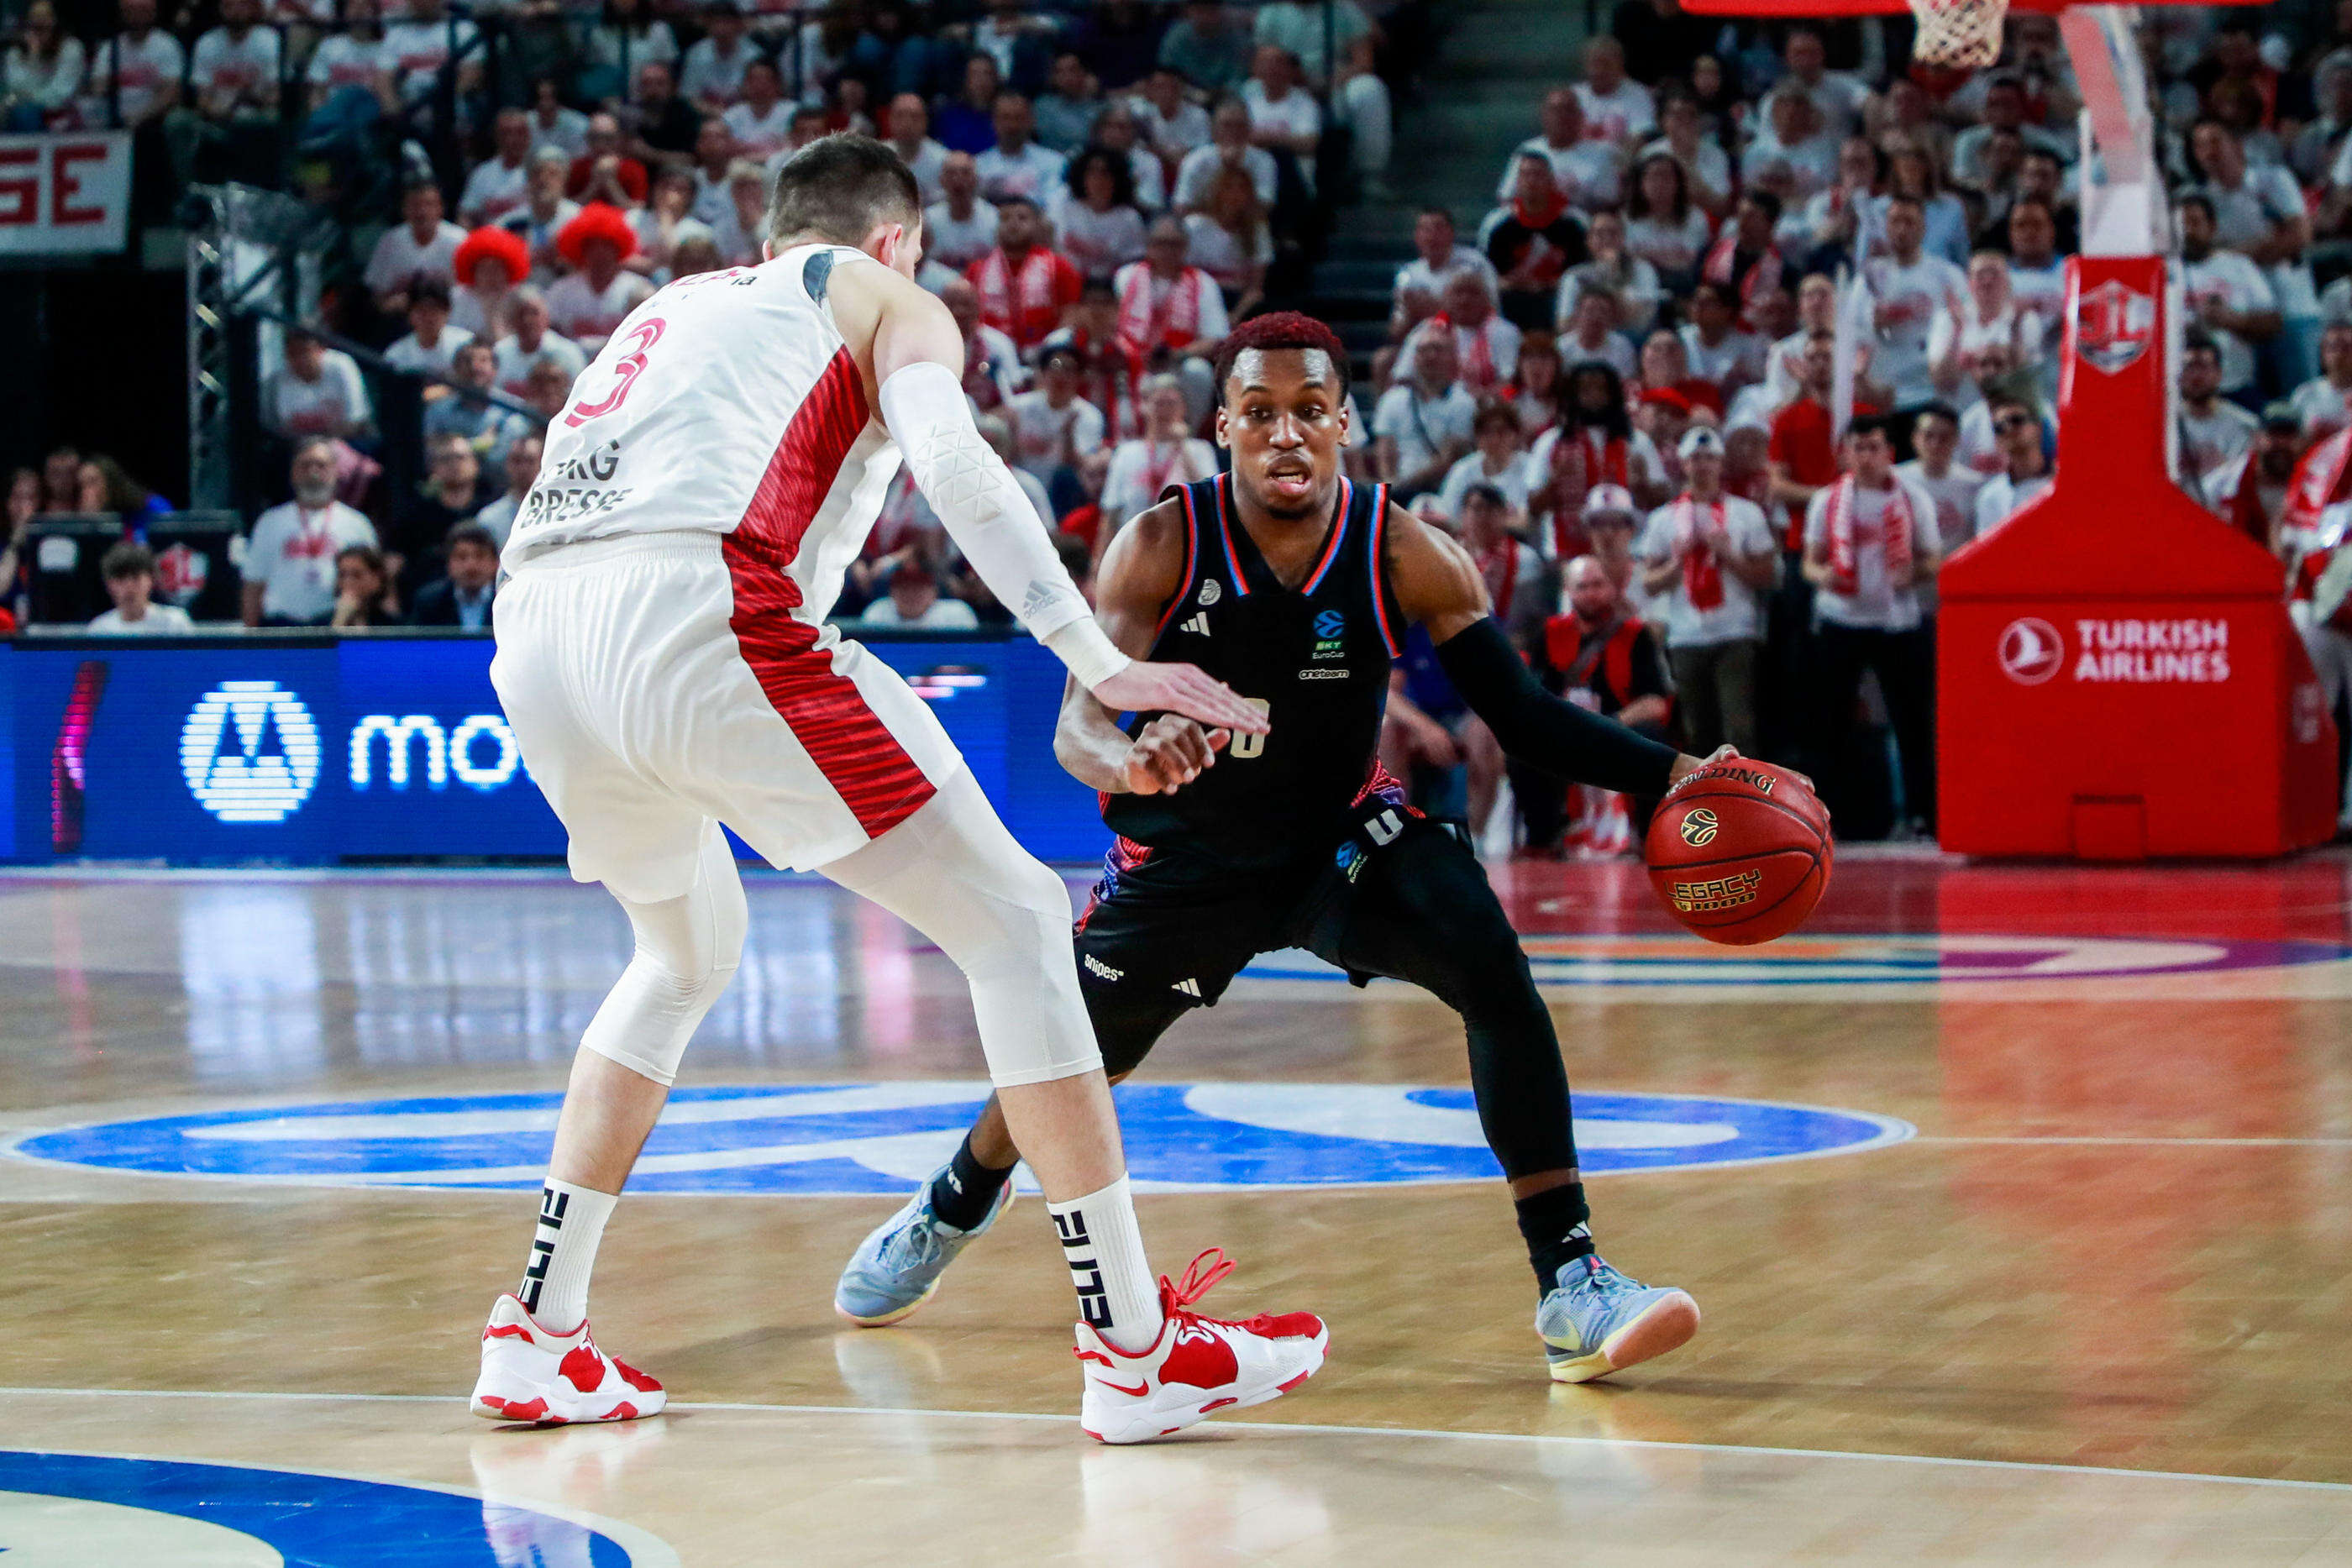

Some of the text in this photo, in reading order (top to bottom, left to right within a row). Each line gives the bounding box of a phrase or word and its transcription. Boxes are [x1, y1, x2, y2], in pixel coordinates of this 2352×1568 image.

[2076, 619, 2228, 649] TURKISH
[2074, 652, 2230, 682] AIRLINES
[1665, 868, 1761, 900] LEGACY
